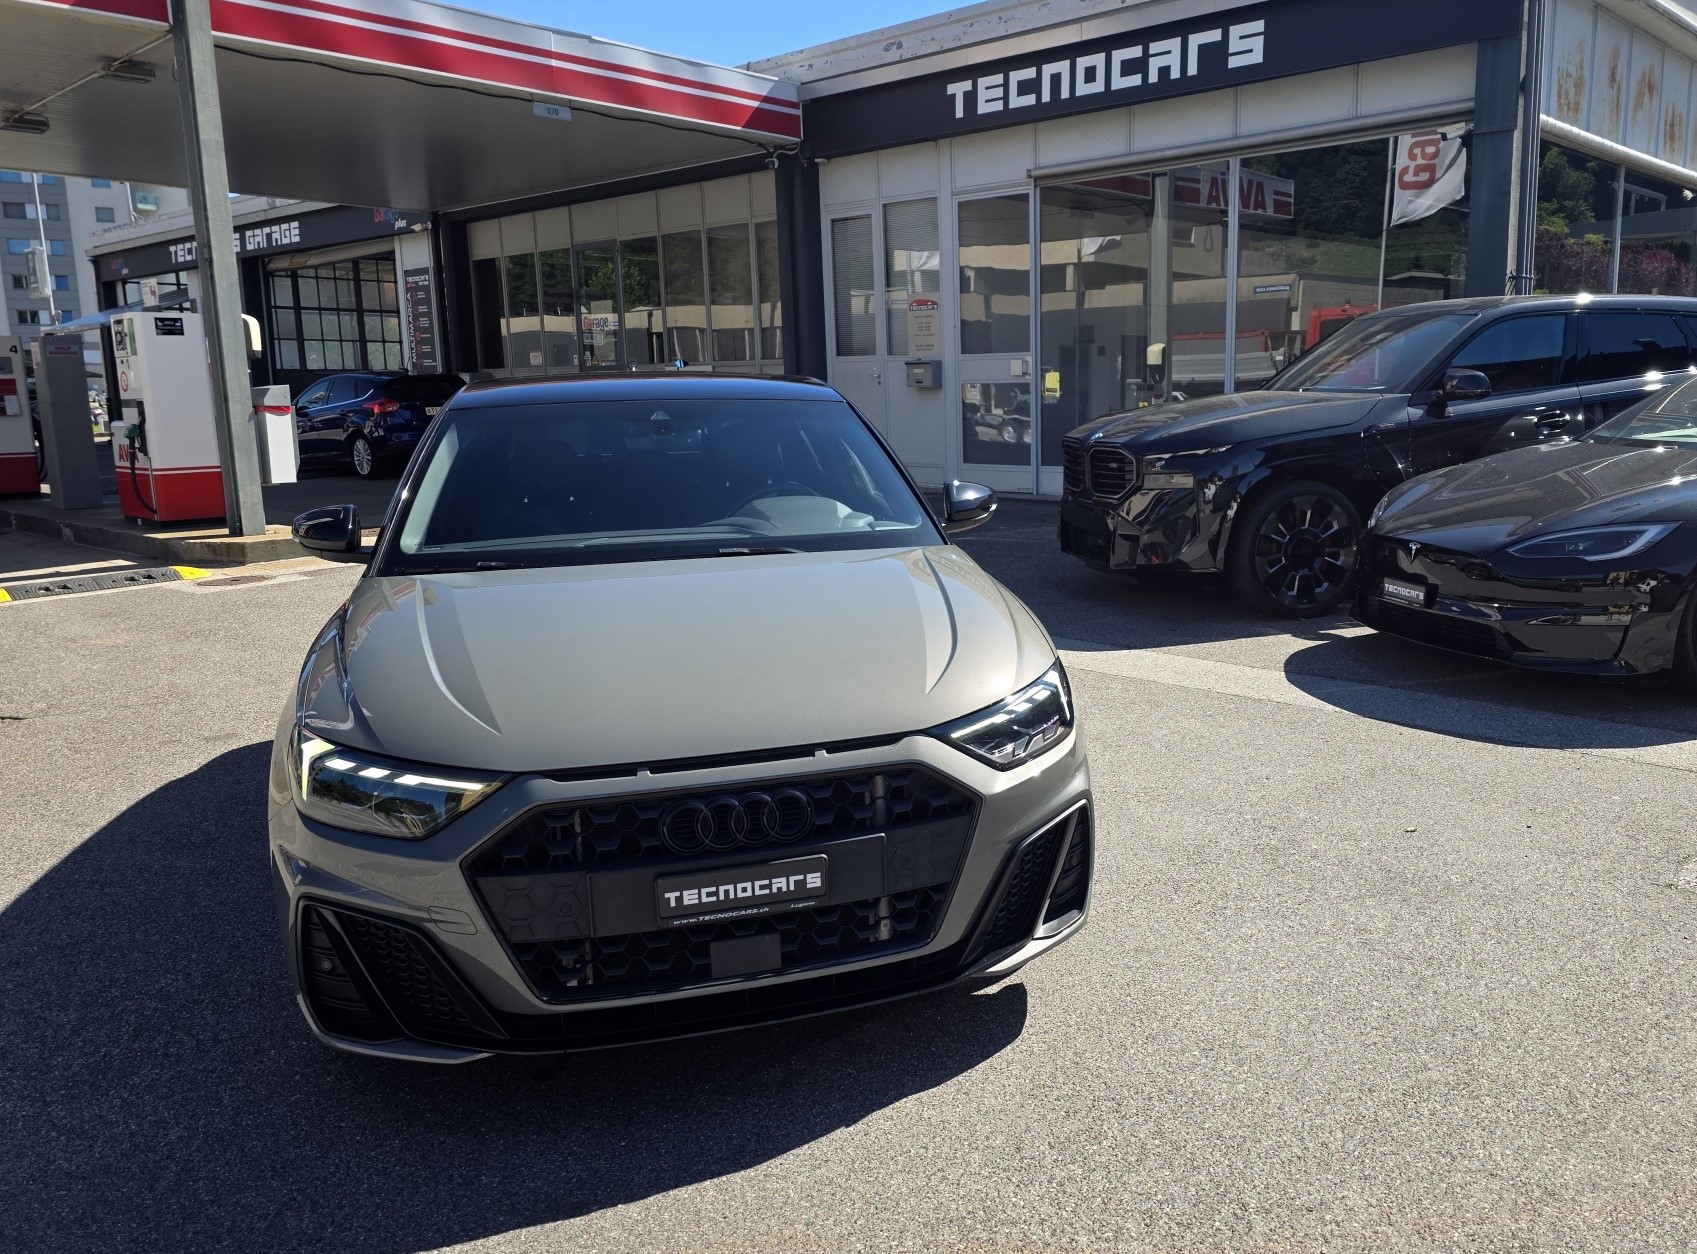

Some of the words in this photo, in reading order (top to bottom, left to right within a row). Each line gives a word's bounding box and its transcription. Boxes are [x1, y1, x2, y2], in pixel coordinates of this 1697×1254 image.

[946, 20, 1265, 119] TECNOCARS
[245, 221, 300, 250] GARAGE
[406, 291, 418, 363] MULTIMARCA
[9, 344, 19, 354] 4
[1385, 583, 1424, 600] TECNOCARS
[665, 872, 822, 907] TECNOCARS
[673, 907, 770, 925] www.TECNOCARS.ch
